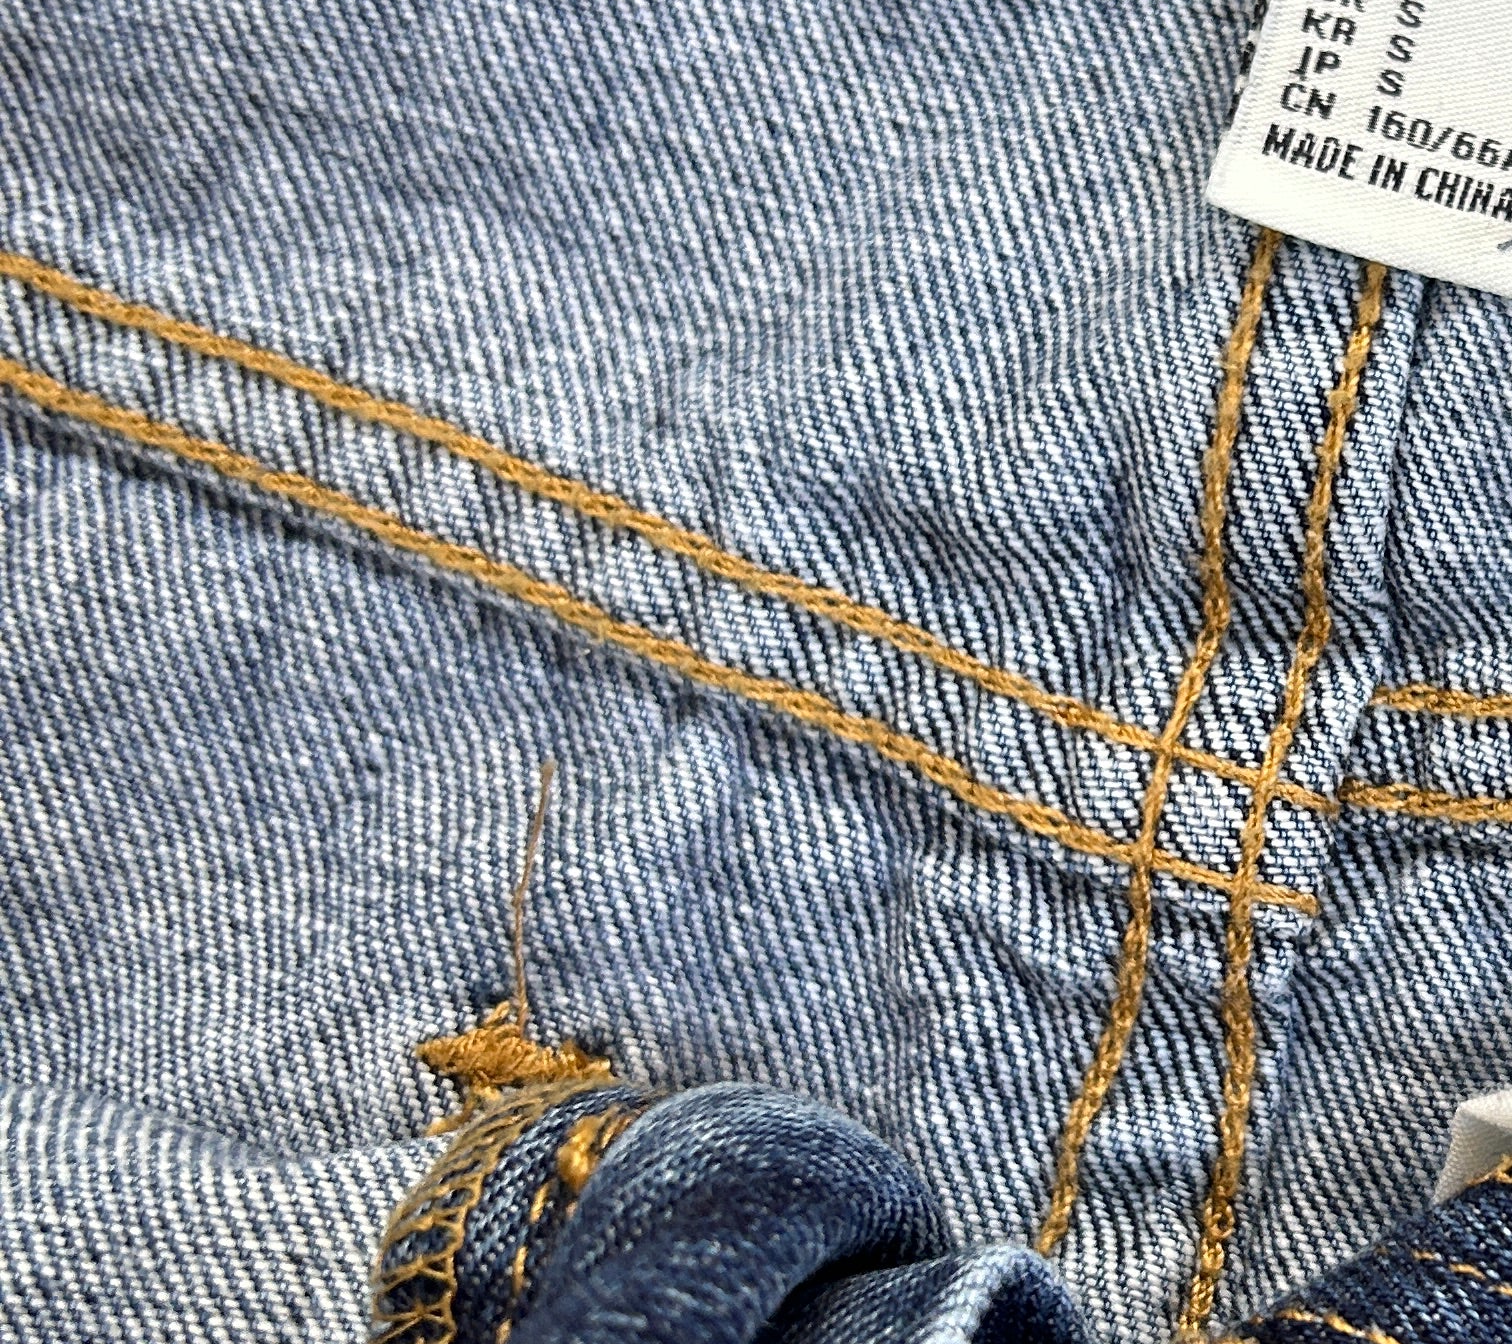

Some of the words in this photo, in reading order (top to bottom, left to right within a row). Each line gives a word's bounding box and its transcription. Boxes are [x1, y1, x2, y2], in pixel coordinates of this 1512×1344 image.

[1300, 7, 1358, 47] KR
[1386, 33, 1416, 64] S
[1288, 45, 1342, 83] JP
[1375, 68, 1406, 98] S
[1280, 81, 1337, 121] CN
[1260, 122, 1362, 181] MADE
[1366, 153, 1409, 194] IN
